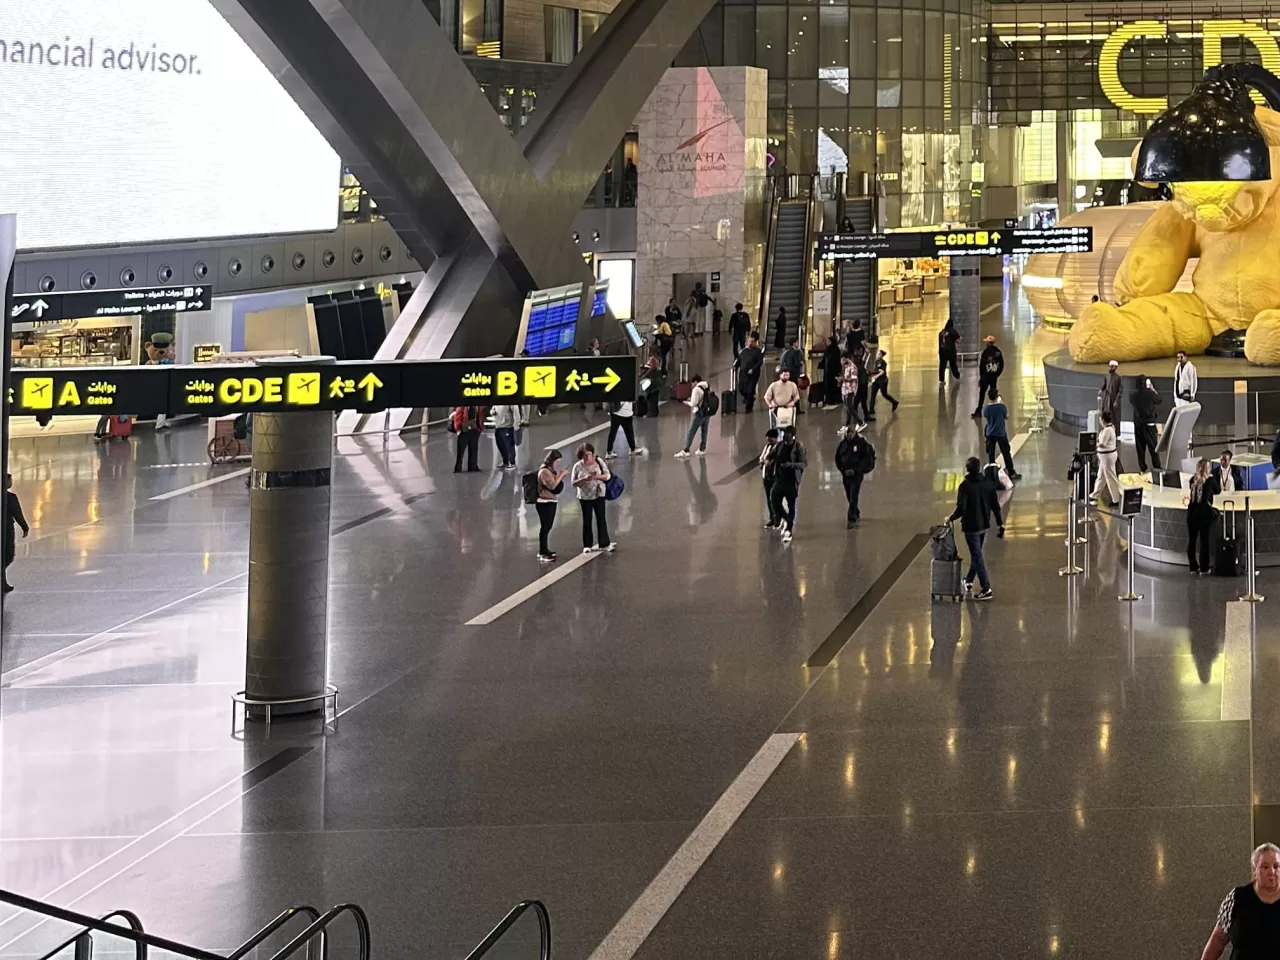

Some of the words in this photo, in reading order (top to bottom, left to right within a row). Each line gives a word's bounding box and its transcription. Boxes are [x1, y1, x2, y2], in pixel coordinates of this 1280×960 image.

[102, 41, 201, 75] advisor.
[681, 151, 726, 163] MAHA
[947, 233, 975, 246] CDE
[461, 372, 492, 385] بوابات
[497, 371, 518, 396] B
[87, 380, 117, 393] بوابات
[185, 379, 215, 392] بوابات
[220, 377, 283, 404] CDE
[463, 386, 491, 397] Gates
[58, 380, 81, 406] A
[87, 394, 113, 405] Gates
[187, 393, 214, 404] Gates
